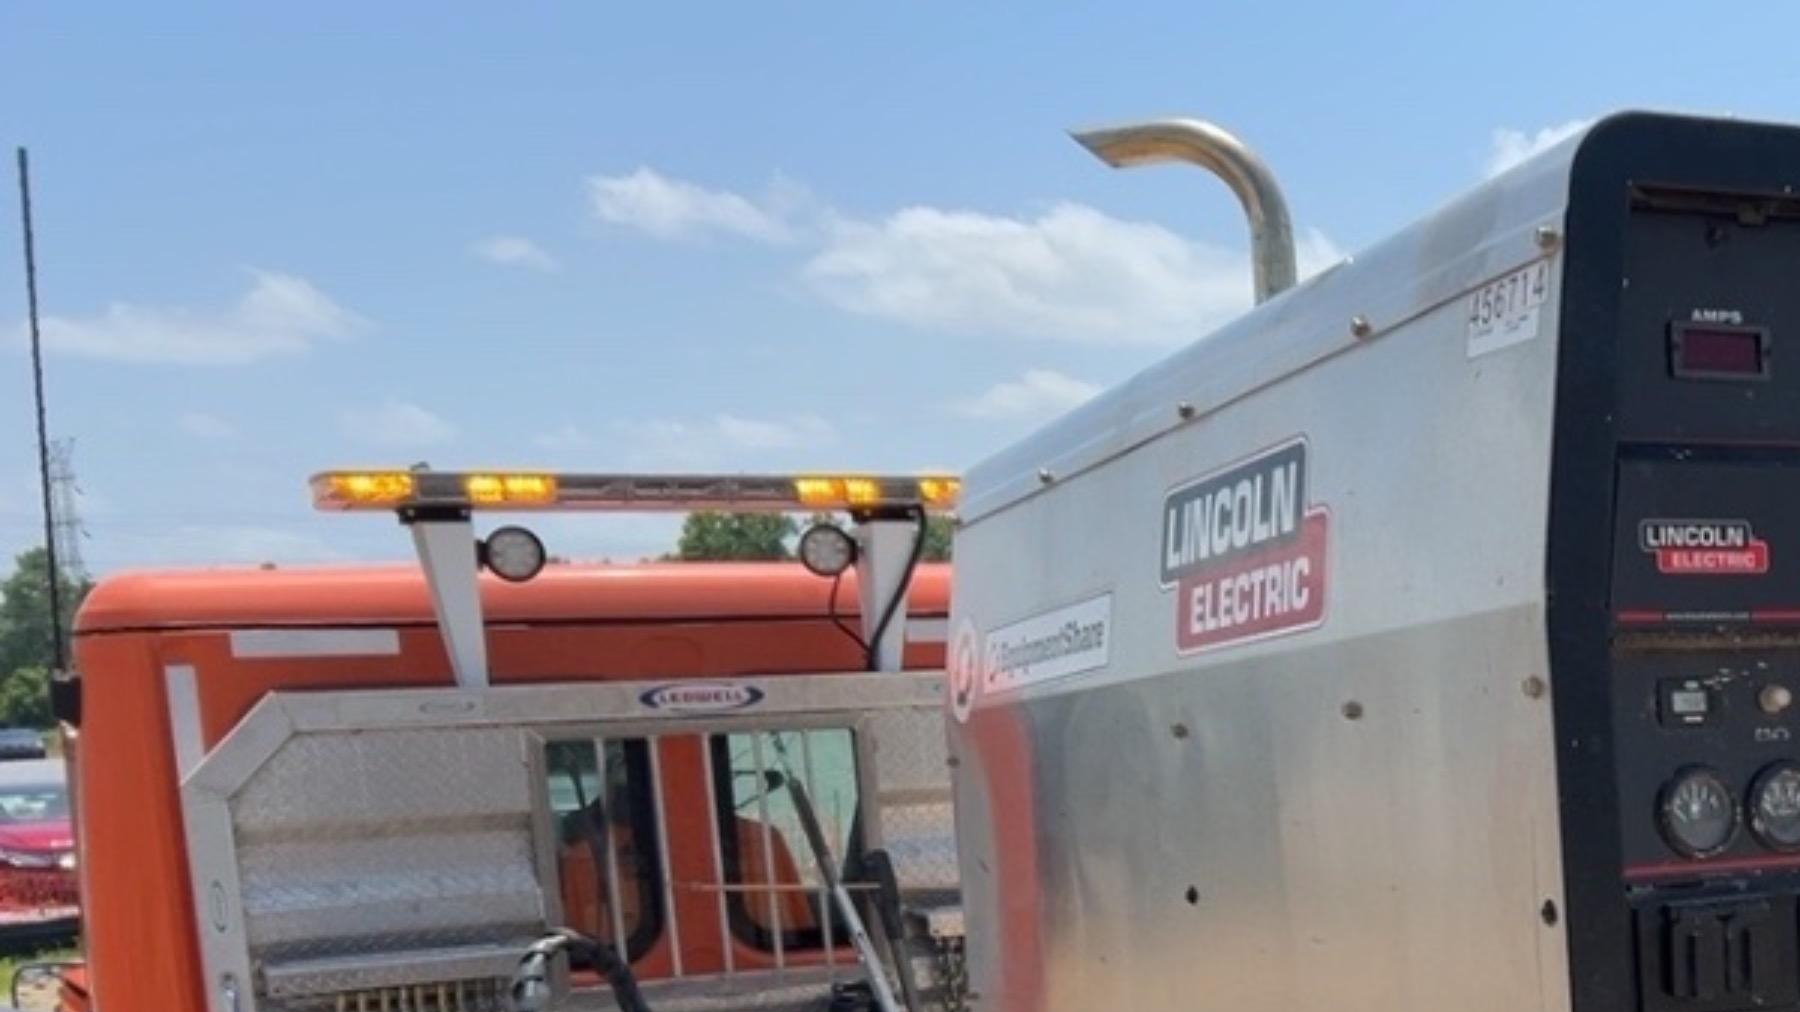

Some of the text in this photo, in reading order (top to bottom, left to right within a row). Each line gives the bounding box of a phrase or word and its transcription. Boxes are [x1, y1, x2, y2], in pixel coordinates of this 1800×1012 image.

[1166, 461, 1298, 572] LINCOLN
[1646, 525, 1745, 547] LINCOLN
[1671, 552, 1756, 569] ELECTRIC
[1190, 556, 1311, 634] ELECTRIC
